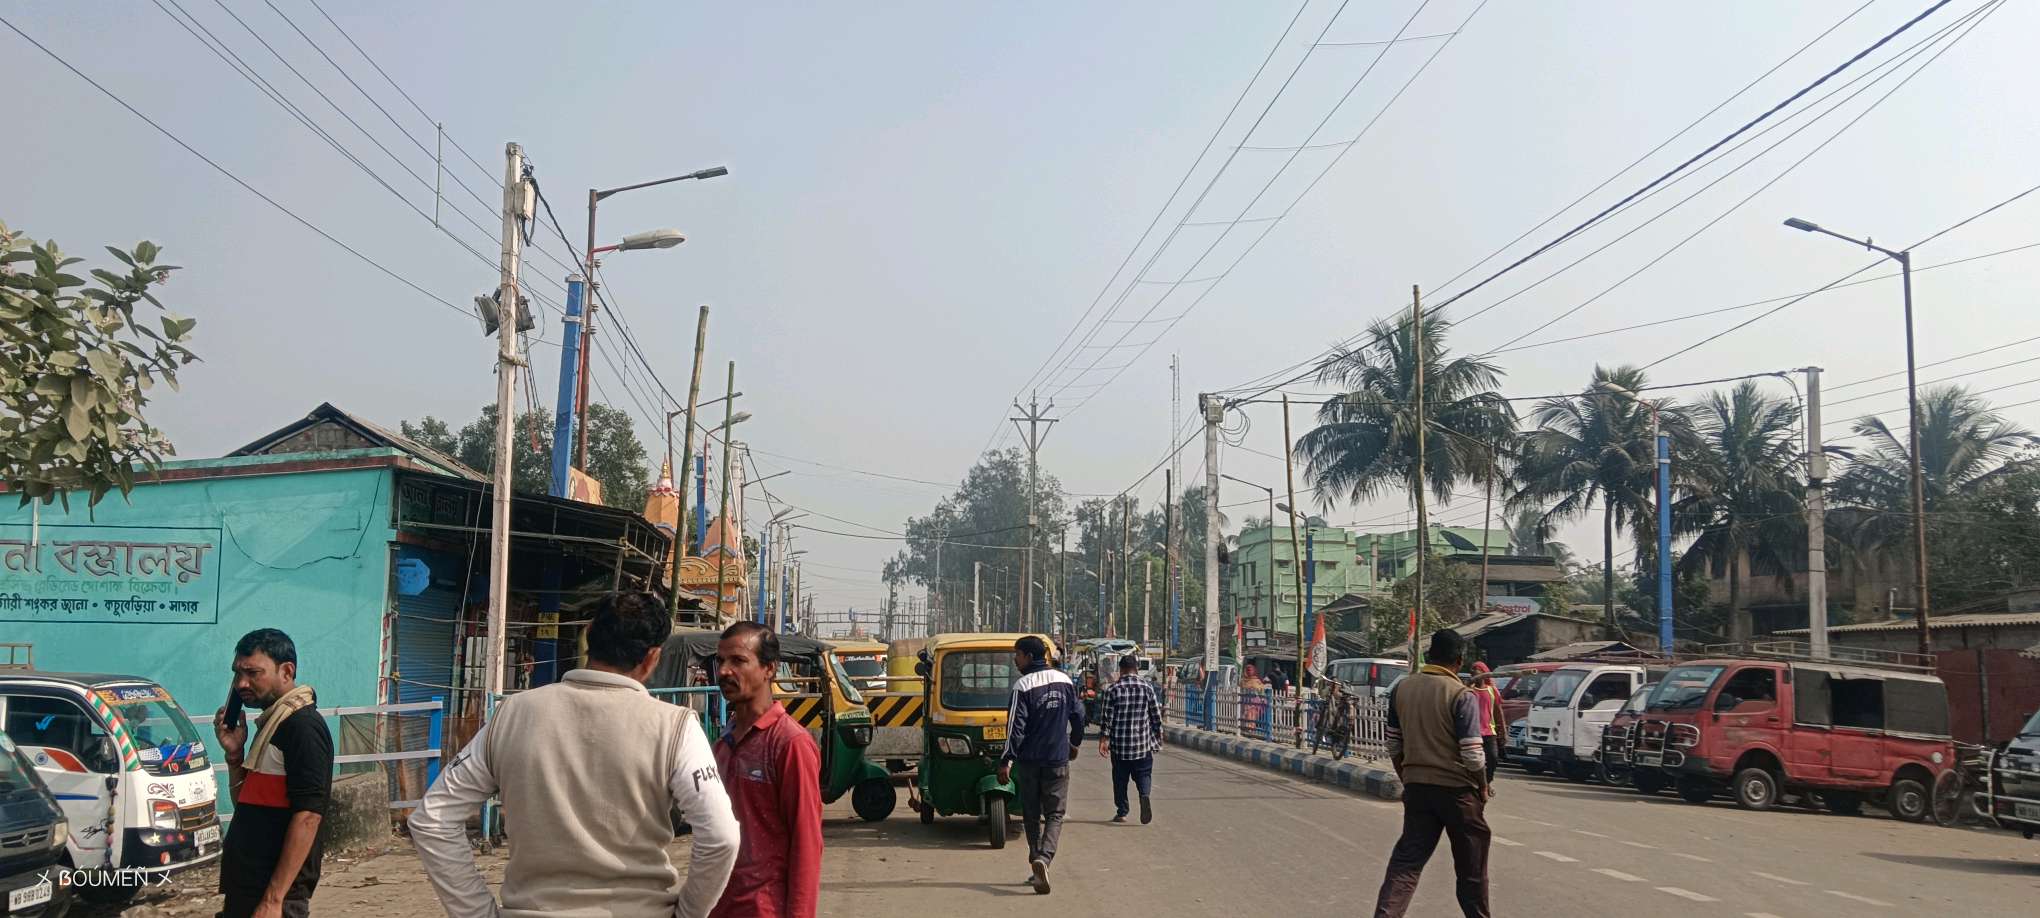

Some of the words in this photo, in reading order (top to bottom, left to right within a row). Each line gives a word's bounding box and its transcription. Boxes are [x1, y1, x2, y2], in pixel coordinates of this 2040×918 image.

[0, 538, 46, 574] না
[52, 539, 212, 583] বস্ত্রালয়
[104, 595, 157, 617] কচুবেড়িয়া
[169, 600, 199, 615] সাগর
